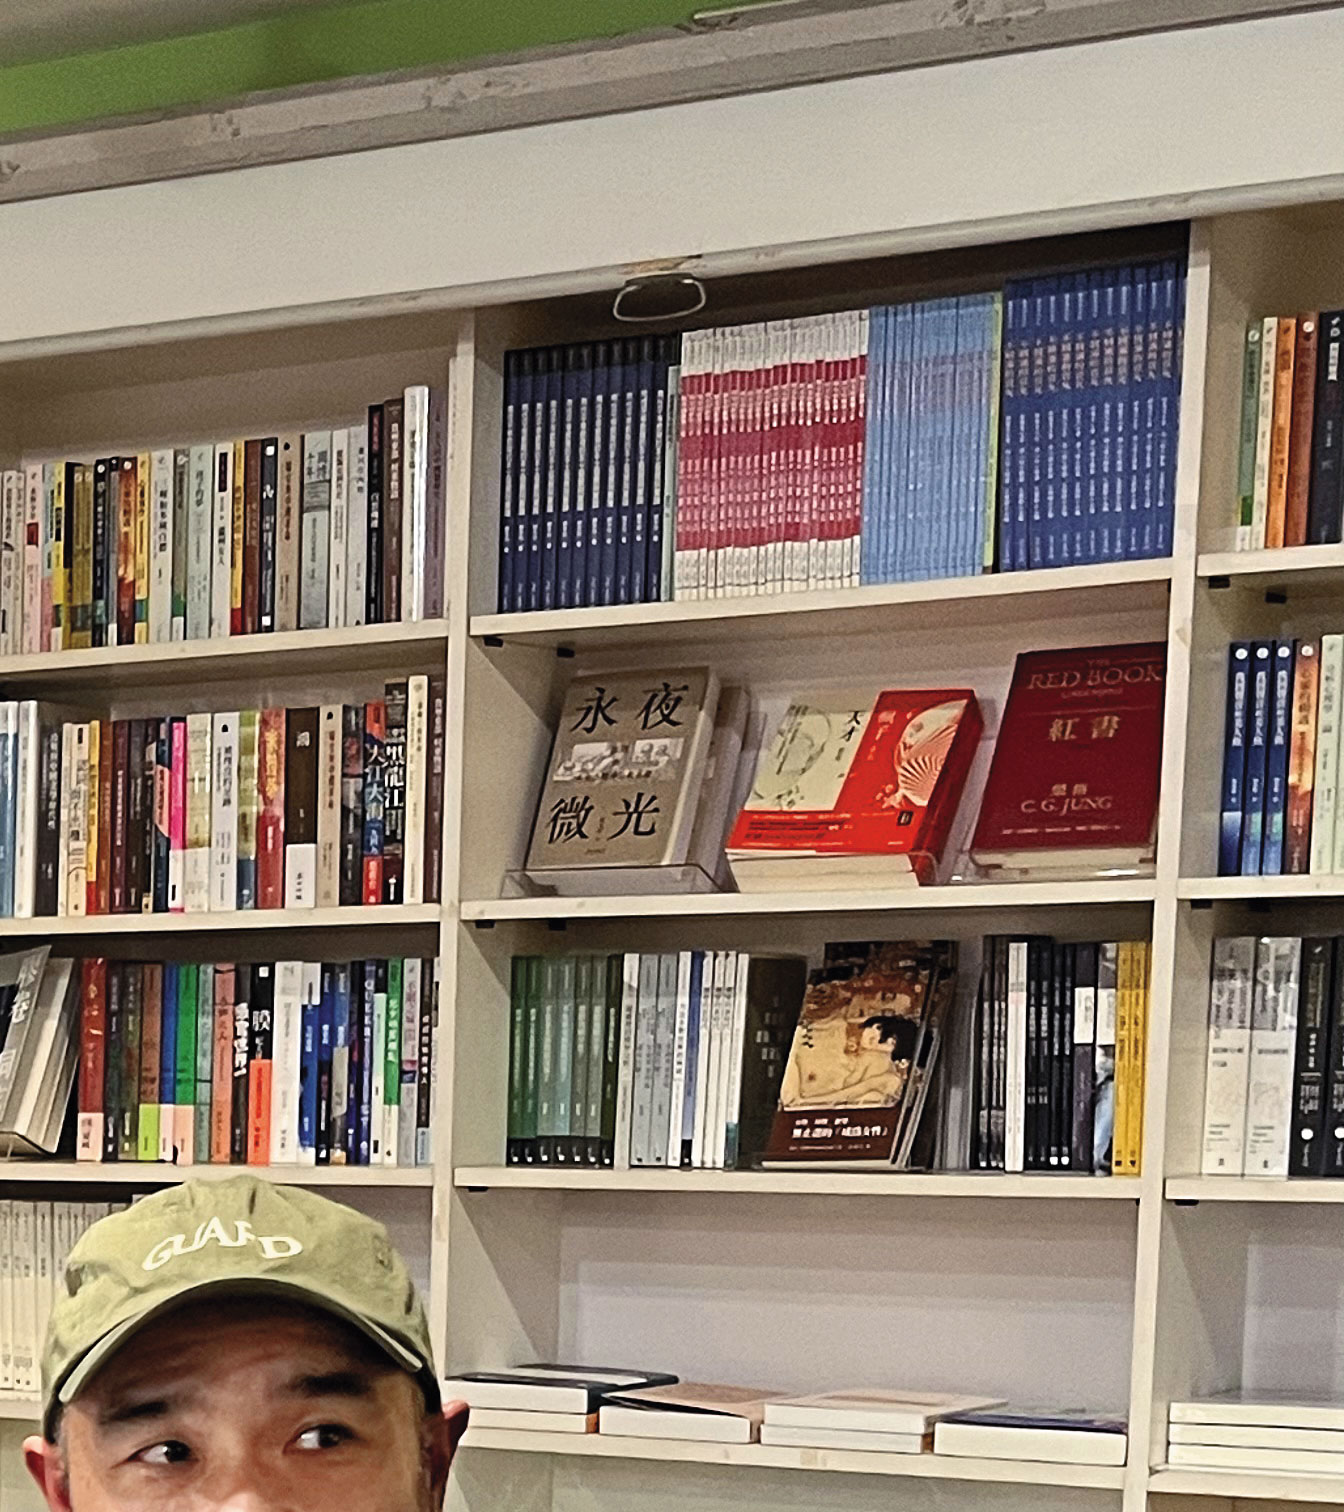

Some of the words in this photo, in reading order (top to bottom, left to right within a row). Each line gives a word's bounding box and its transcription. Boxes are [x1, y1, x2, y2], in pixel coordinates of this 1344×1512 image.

[1027, 669, 1083, 691] RED
[1087, 665, 1163, 688] BOOK
[570, 682, 690, 735] 永夜
[1047, 716, 1120, 742] 紅書
[547, 792, 662, 845] 微光
[1059, 796, 1113, 816] JUNG
